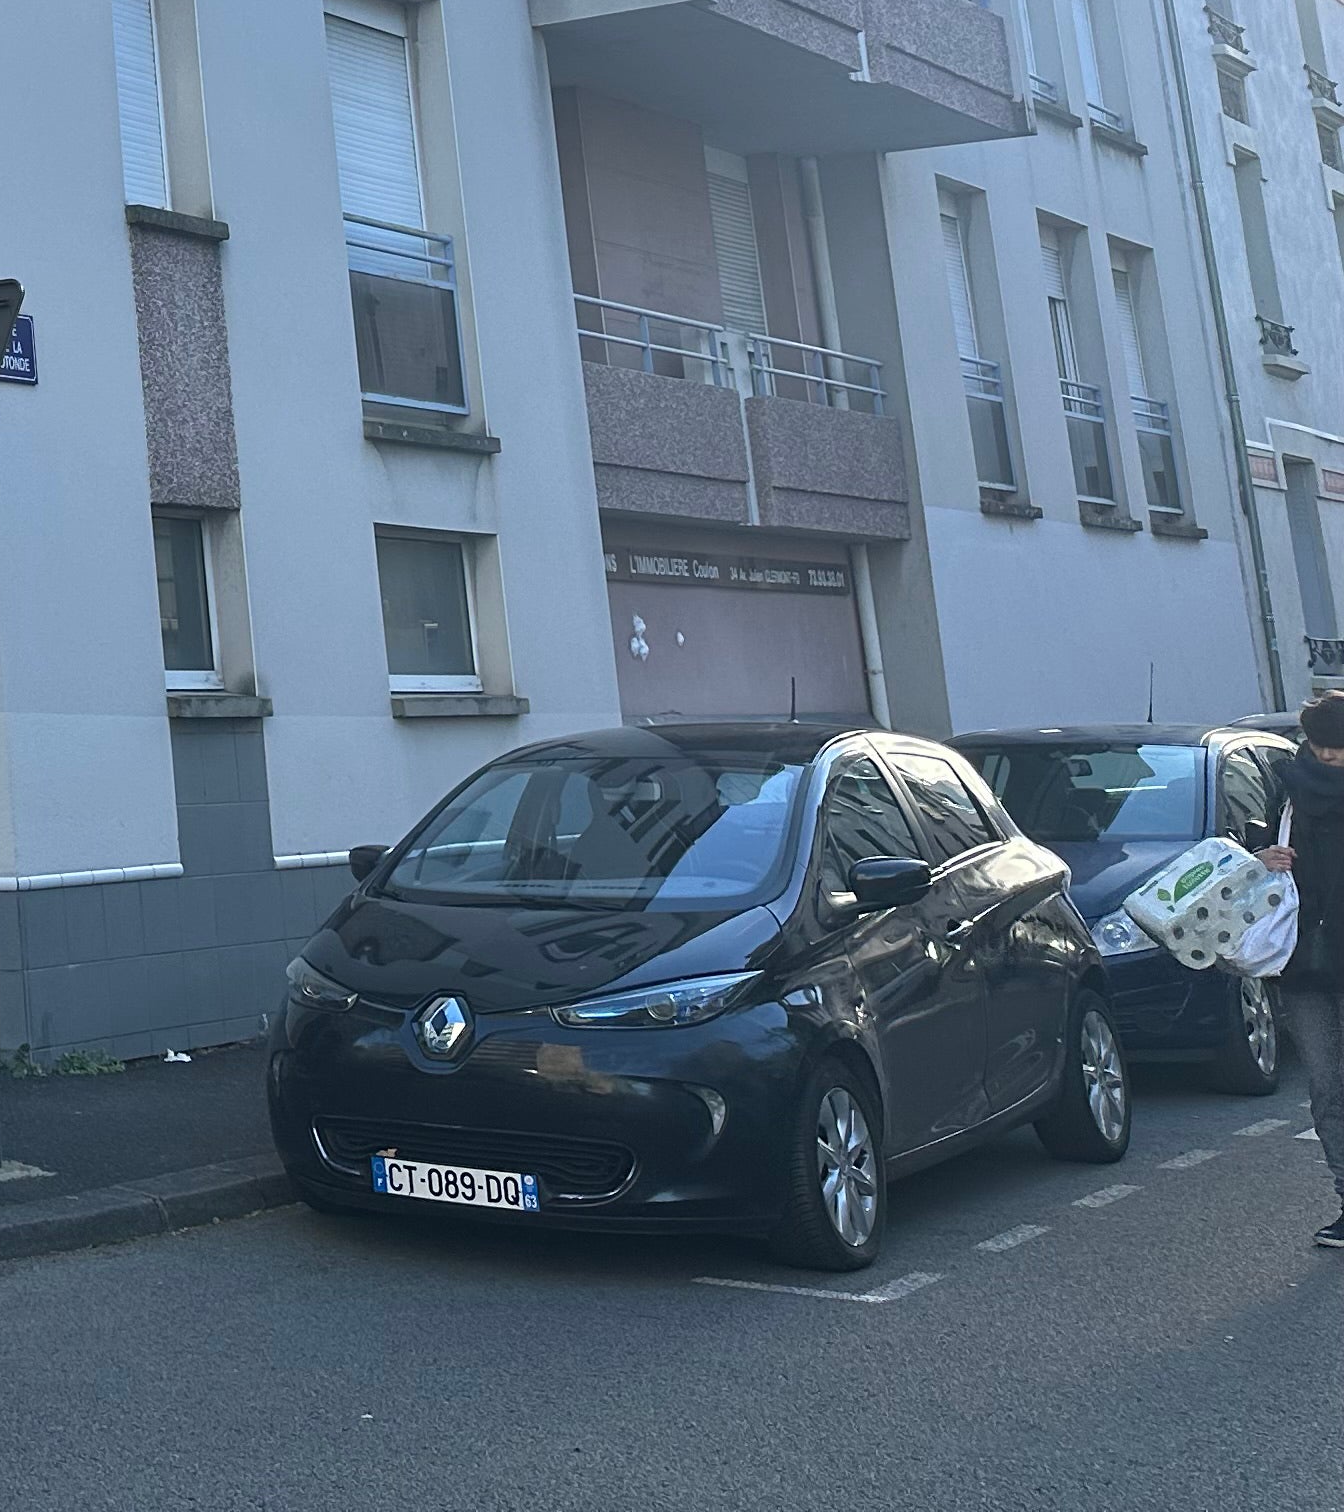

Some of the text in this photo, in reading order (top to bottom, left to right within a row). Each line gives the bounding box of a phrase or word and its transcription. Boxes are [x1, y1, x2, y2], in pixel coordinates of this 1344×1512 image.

[12, 340, 23, 355] LA
[692, 559, 720, 579] Coulon
[388, 1163, 521, 1207] CT-089-DQ
[524, 1194, 538, 1209] 63
